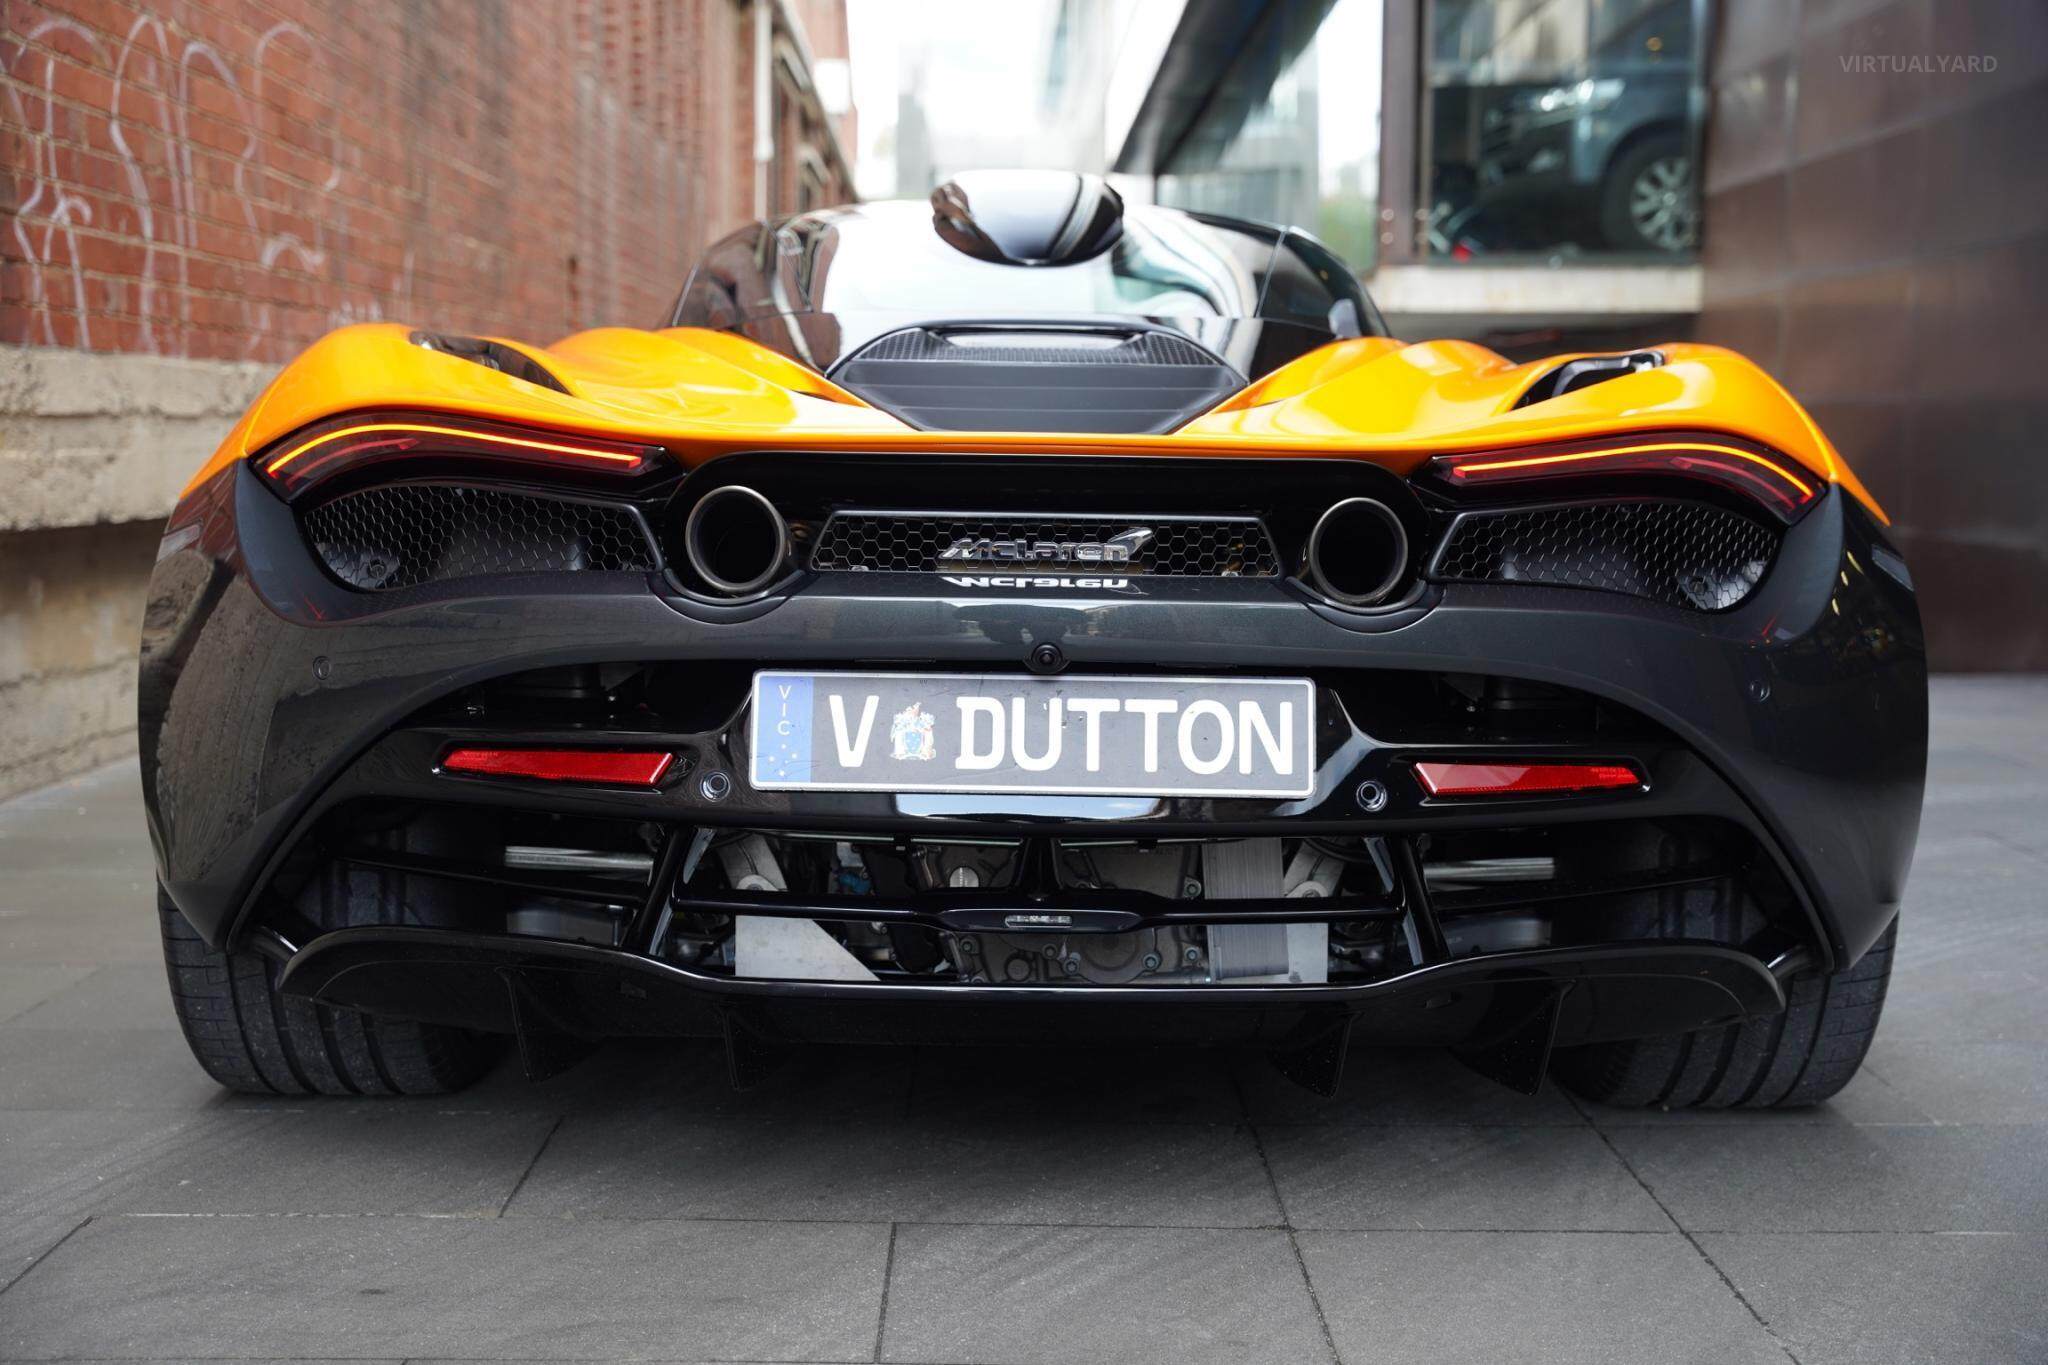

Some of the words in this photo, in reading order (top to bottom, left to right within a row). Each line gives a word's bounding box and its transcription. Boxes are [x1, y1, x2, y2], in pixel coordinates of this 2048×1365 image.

[938, 537, 1131, 562] McLaren
[777, 684, 792, 736] VIC
[828, 695, 880, 768] V
[954, 696, 1294, 776] DUTTON
